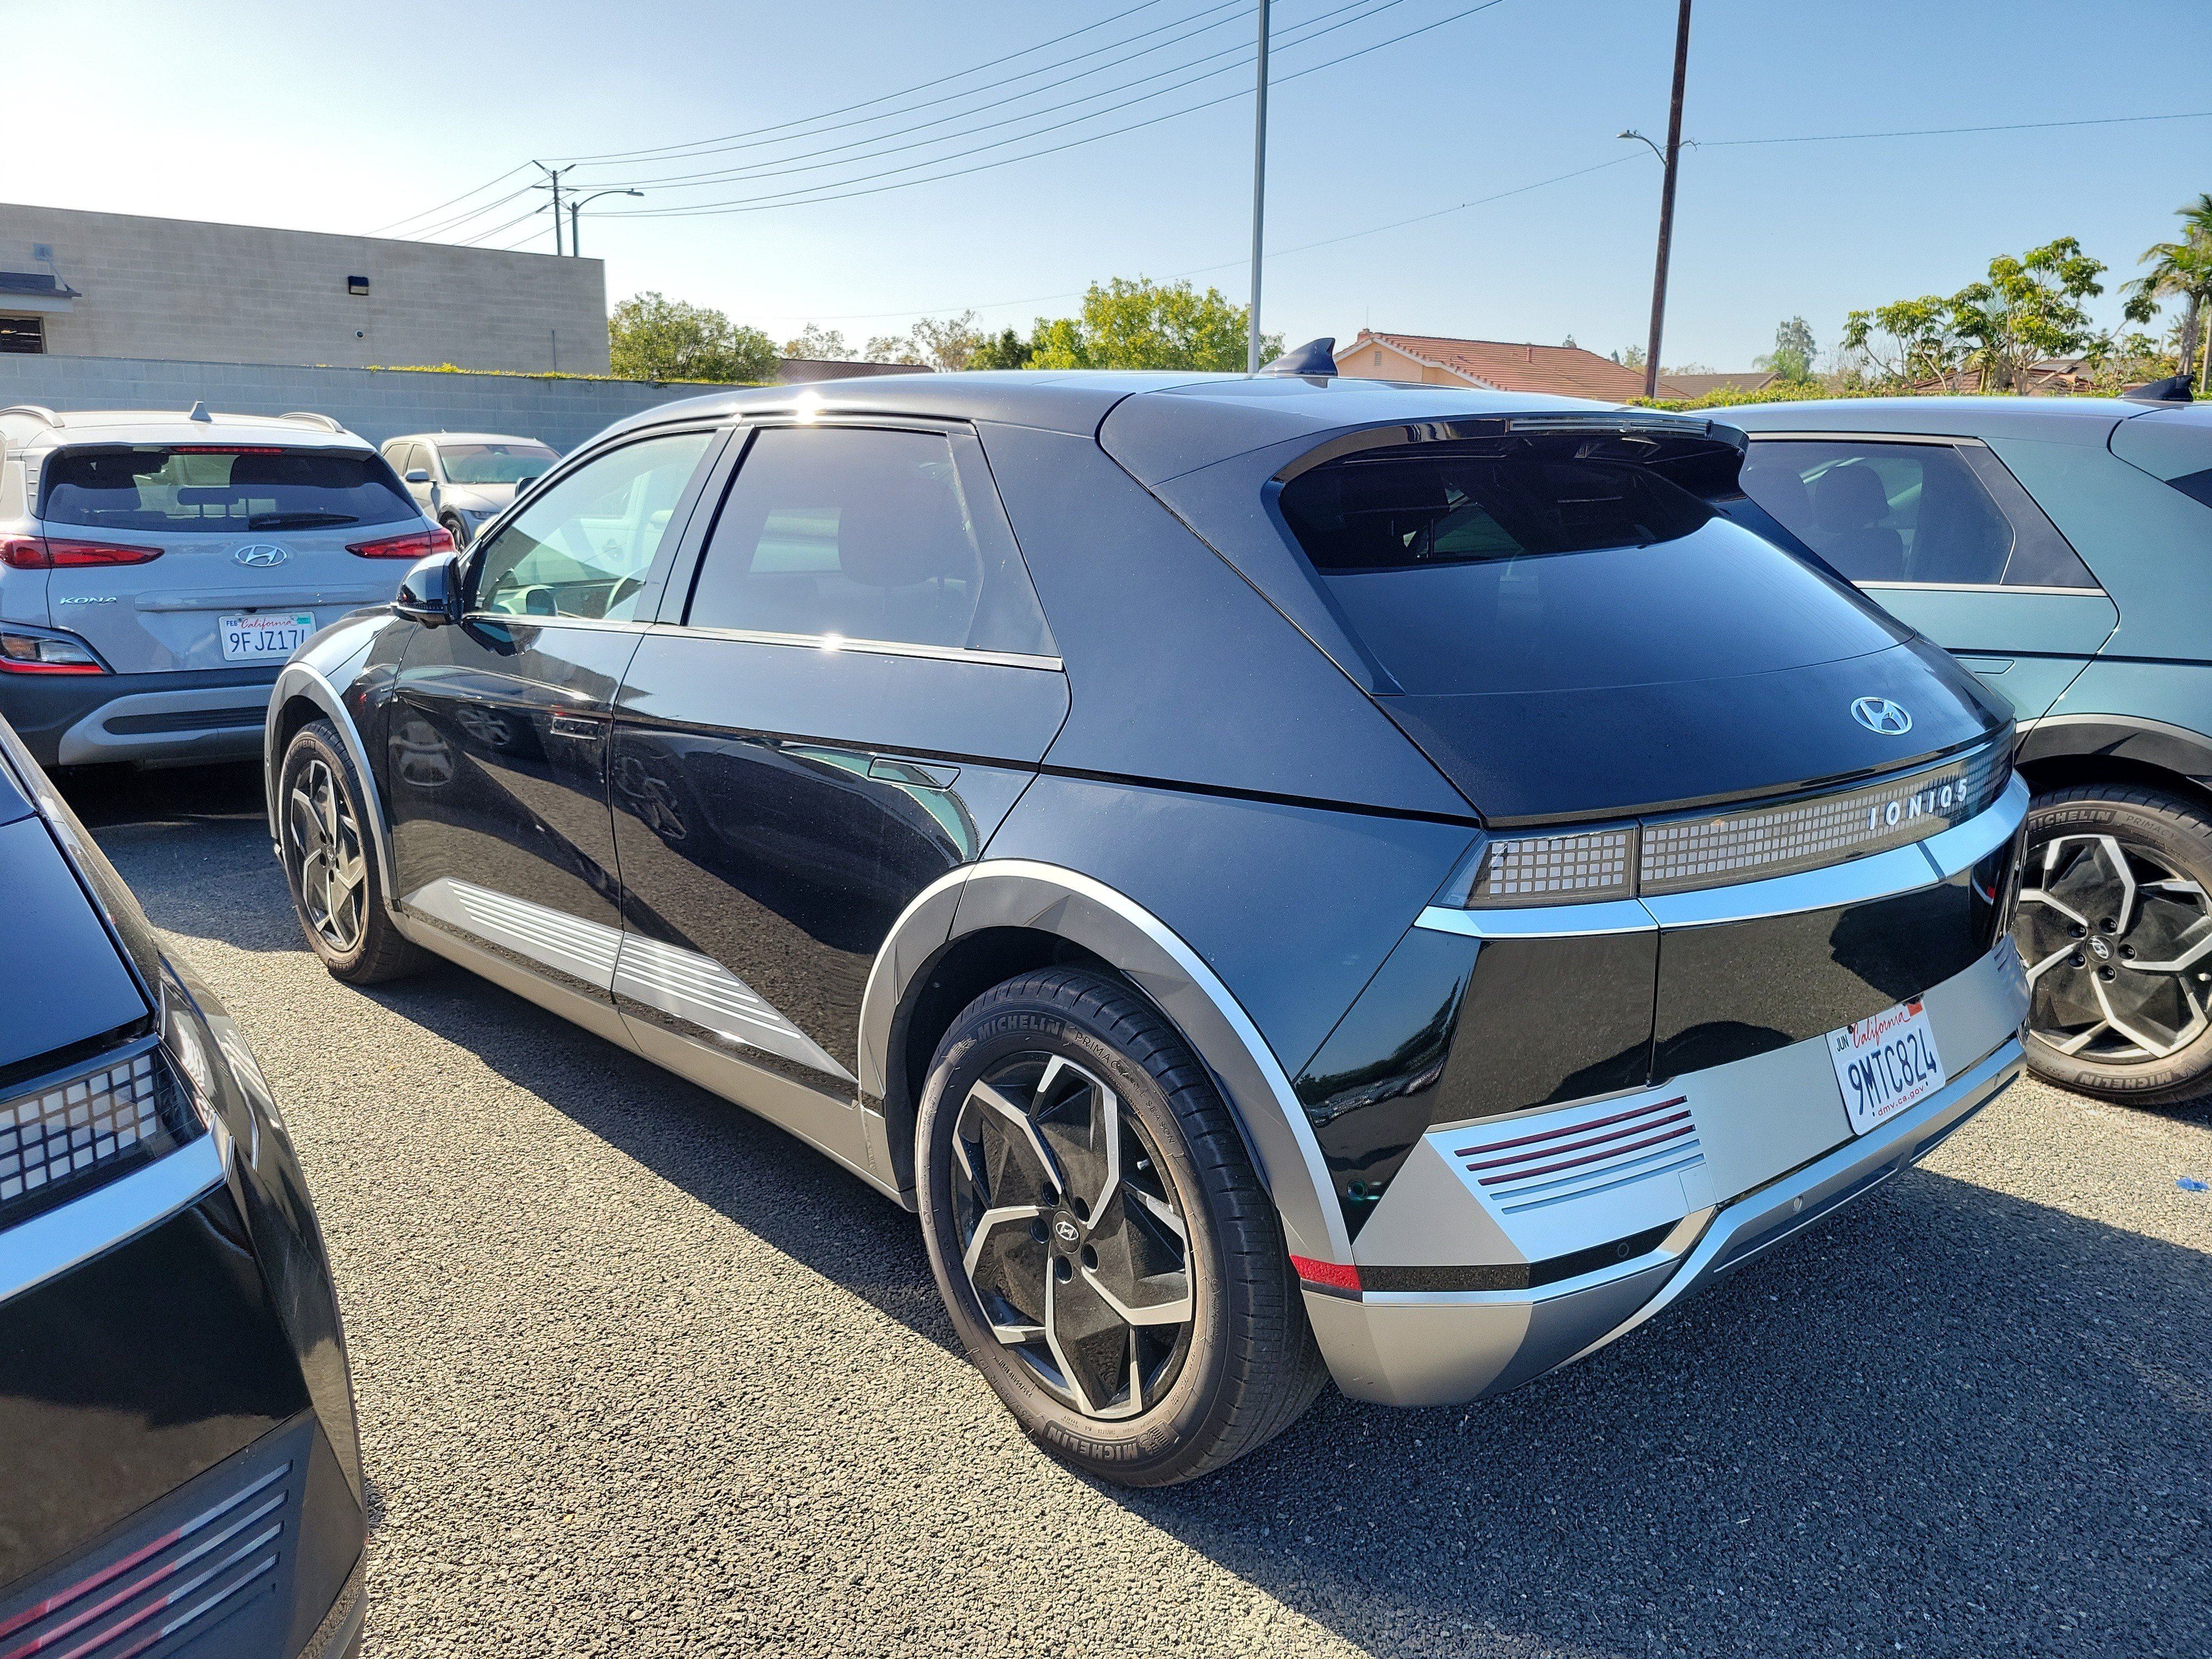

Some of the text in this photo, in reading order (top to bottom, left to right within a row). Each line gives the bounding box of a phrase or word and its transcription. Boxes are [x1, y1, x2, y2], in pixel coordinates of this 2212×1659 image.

[241, 617, 296, 630] California
[1869, 778, 1967, 830] IONIQ 5
[2126, 815, 2178, 838] PRIMACY
[1836, 1034, 1849, 1052] JUN
[1853, 1007, 1911, 1048] California
[978, 1015, 1060, 1039] MICHELIN
[1075, 1031, 1128, 1076] PRIMACY
[1146, 1101, 1176, 1144] SEASON
[1848, 1028, 1937, 1115] 9MTC824
[2080, 1071, 2172, 1089] MICHELIN
[1878, 1085, 1924, 1116] dmv.ca.gov
[1047, 1426, 1139, 1460] MICHELIN
